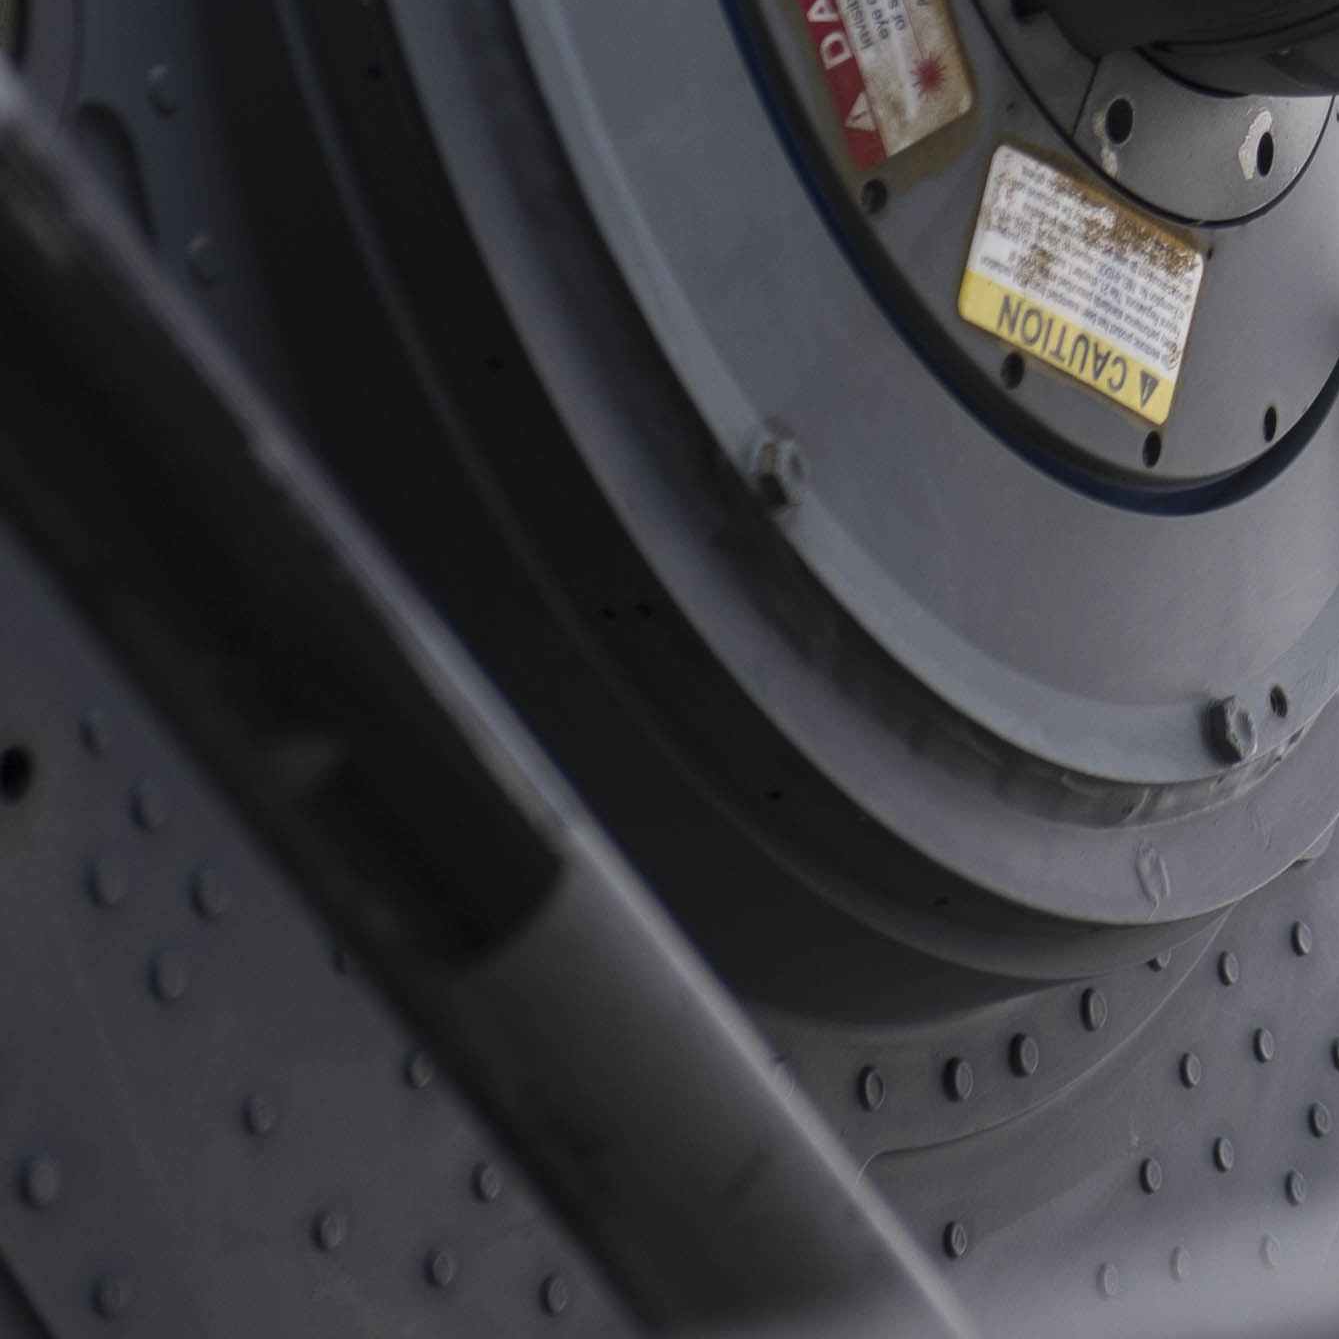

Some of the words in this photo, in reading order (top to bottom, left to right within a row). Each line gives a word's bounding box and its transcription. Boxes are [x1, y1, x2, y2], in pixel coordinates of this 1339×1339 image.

[870, 8, 889, 40] eye
[891, 13, 906, 31] or
[997, 293, 1126, 390] CAUTION
